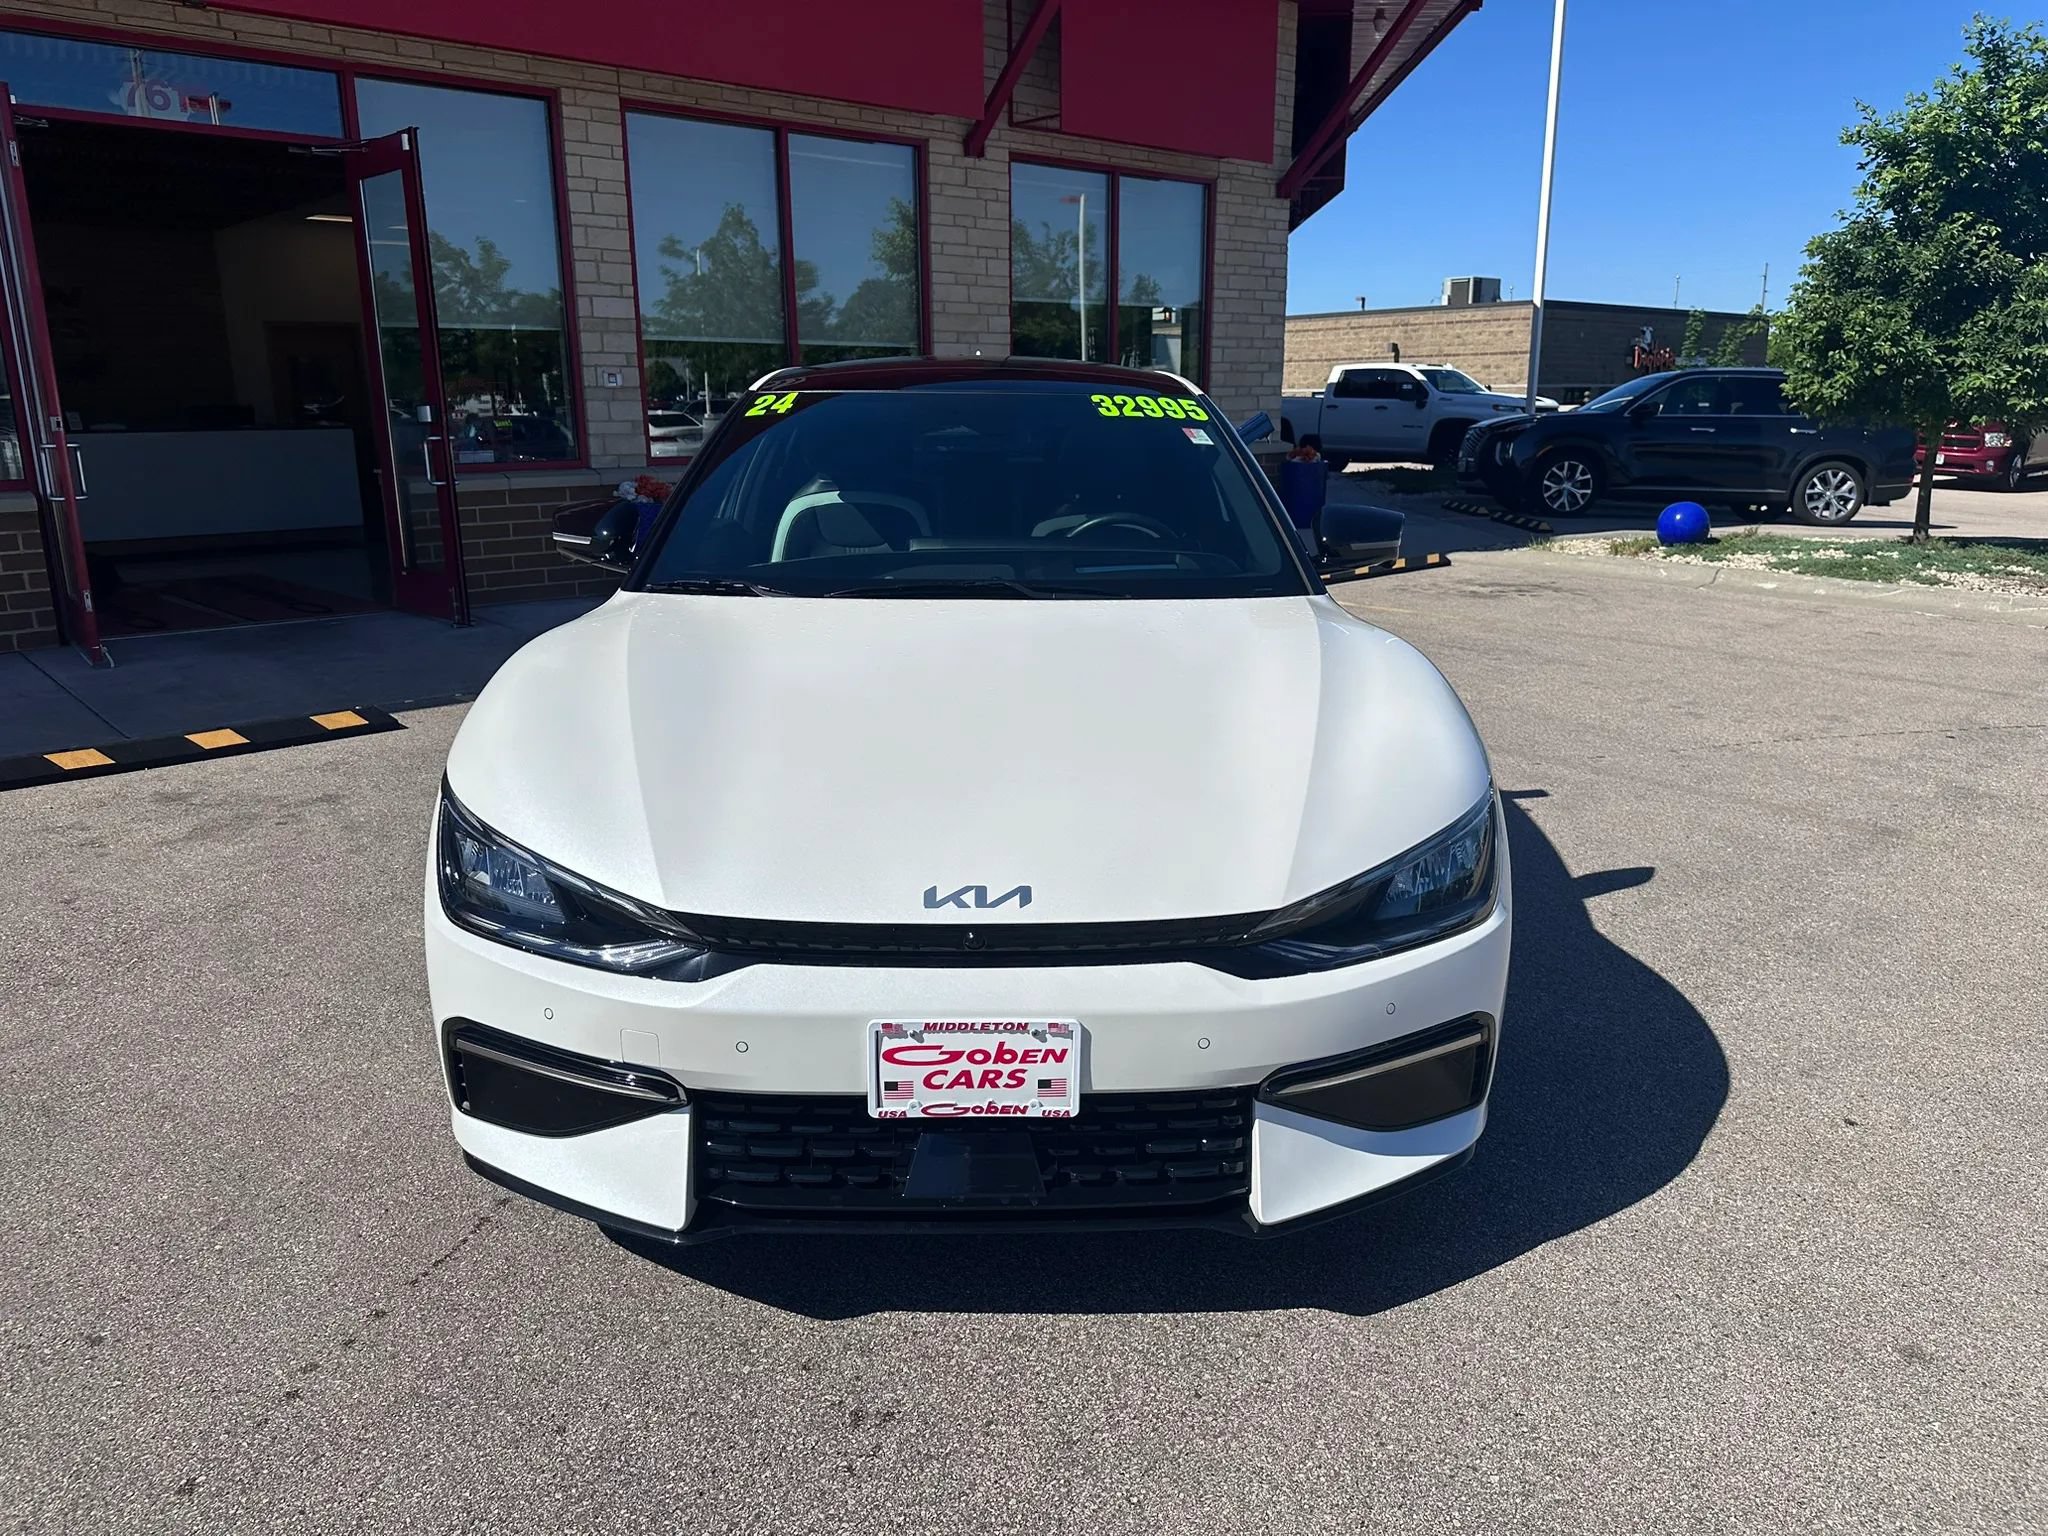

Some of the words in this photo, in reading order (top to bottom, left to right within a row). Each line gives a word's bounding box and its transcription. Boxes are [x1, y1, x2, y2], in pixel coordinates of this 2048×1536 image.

[744, 392, 799, 417] 24
[1090, 394, 1209, 421] 32995
[923, 885, 1033, 909] KIA
[923, 1022, 1029, 1031] MIDDLETON
[922, 1068, 1029, 1090] CARS
[877, 1110, 908, 1118] USA
[1041, 1109, 1071, 1118] USA
